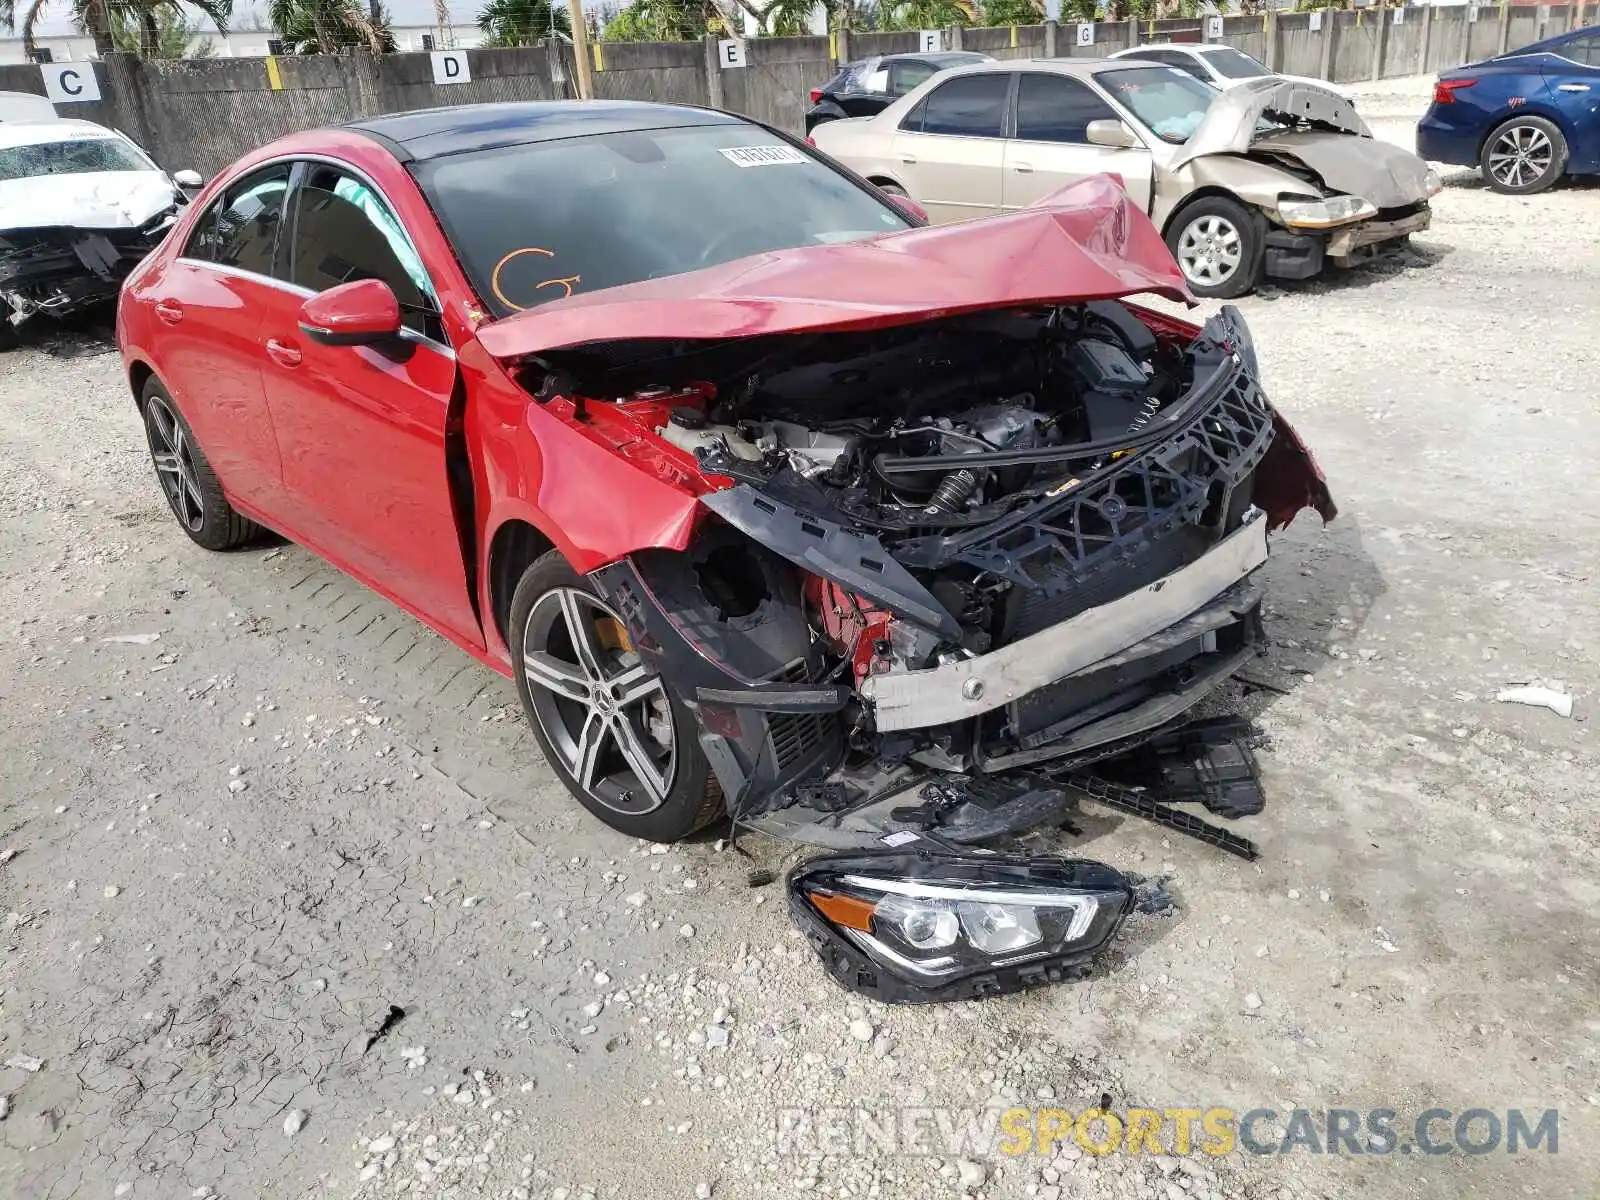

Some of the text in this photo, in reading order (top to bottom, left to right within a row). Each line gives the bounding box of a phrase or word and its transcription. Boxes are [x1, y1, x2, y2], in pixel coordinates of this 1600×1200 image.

[927, 35, 935, 51] F
[1082, 27, 1089, 42] G
[726, 44, 738, 63] E
[443, 57, 460, 78] D
[59, 70, 83, 96] C
